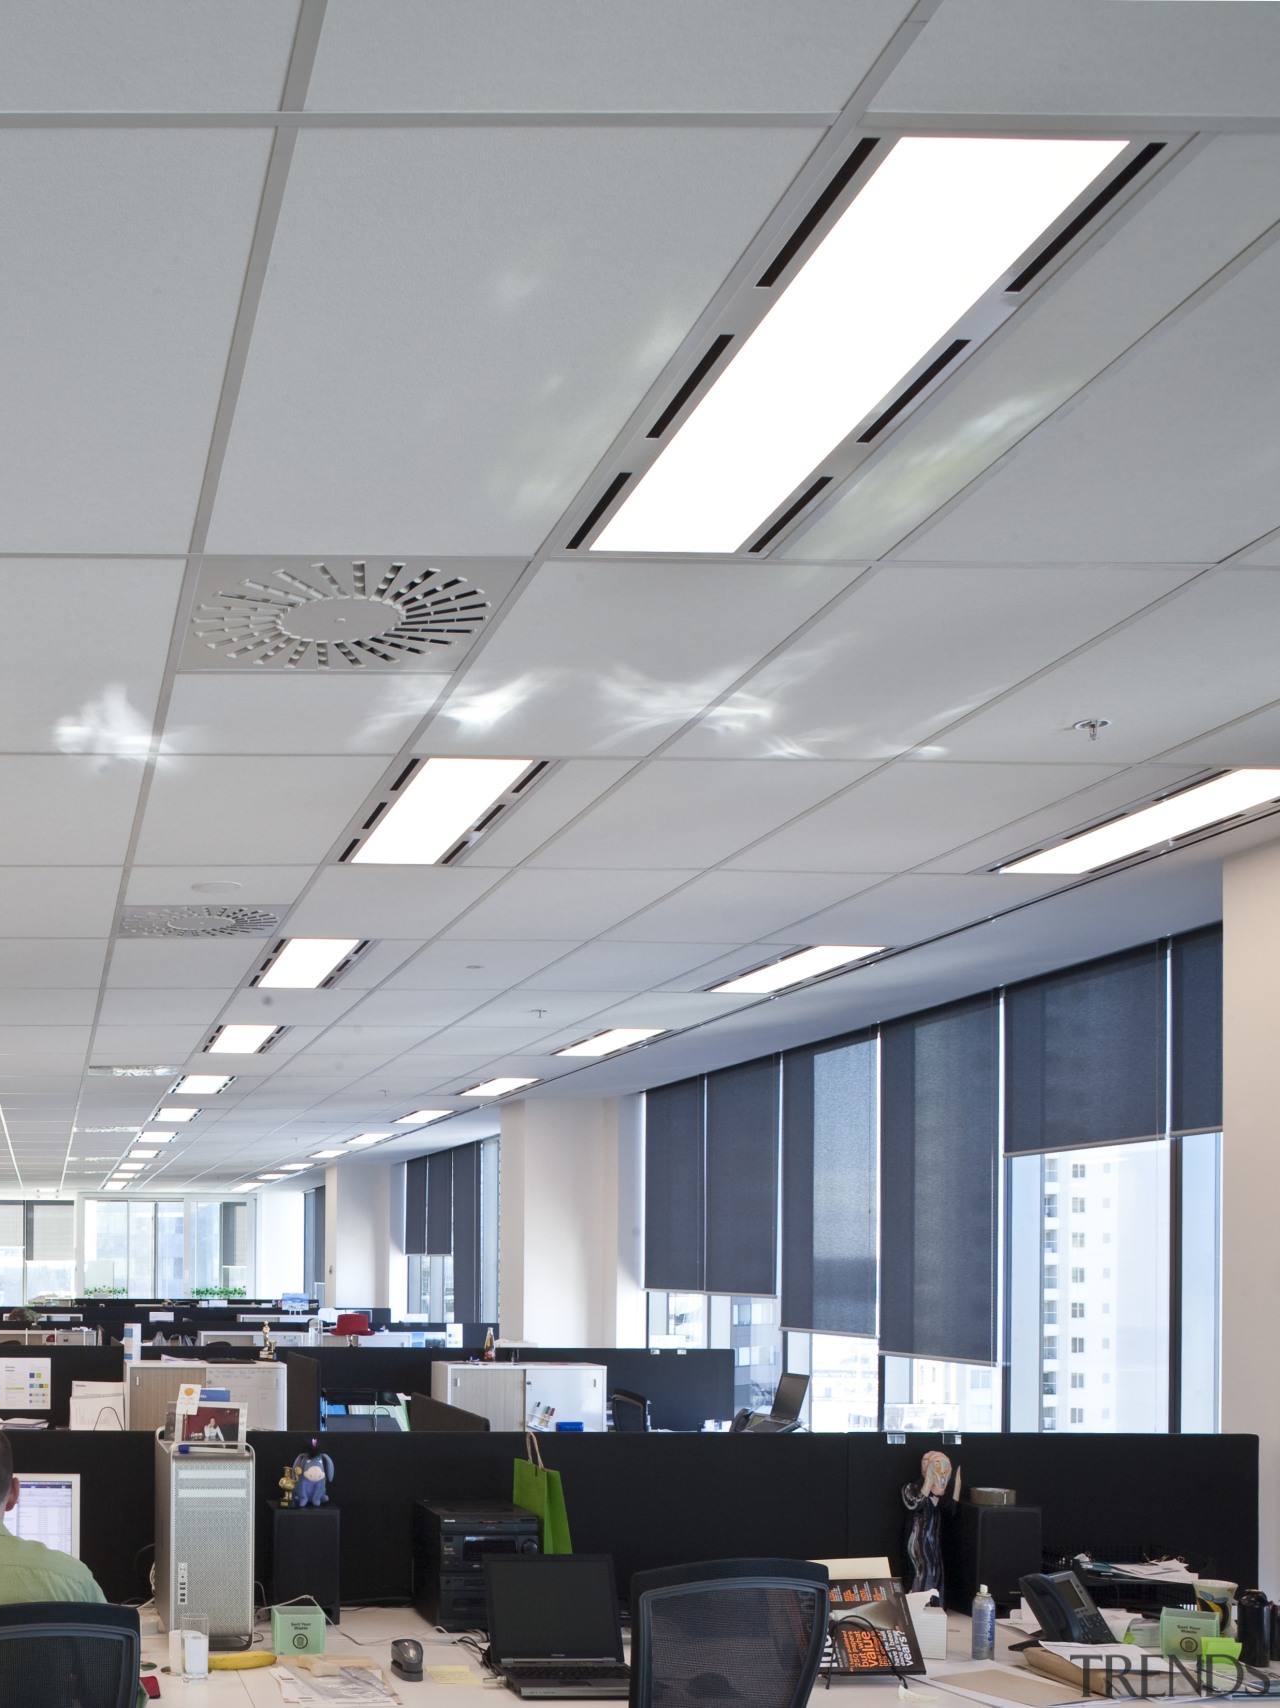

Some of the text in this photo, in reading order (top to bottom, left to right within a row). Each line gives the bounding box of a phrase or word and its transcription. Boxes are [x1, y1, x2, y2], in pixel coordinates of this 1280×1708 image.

[853, 1630, 868, 1666] but what
[861, 1631, 878, 1667] value
